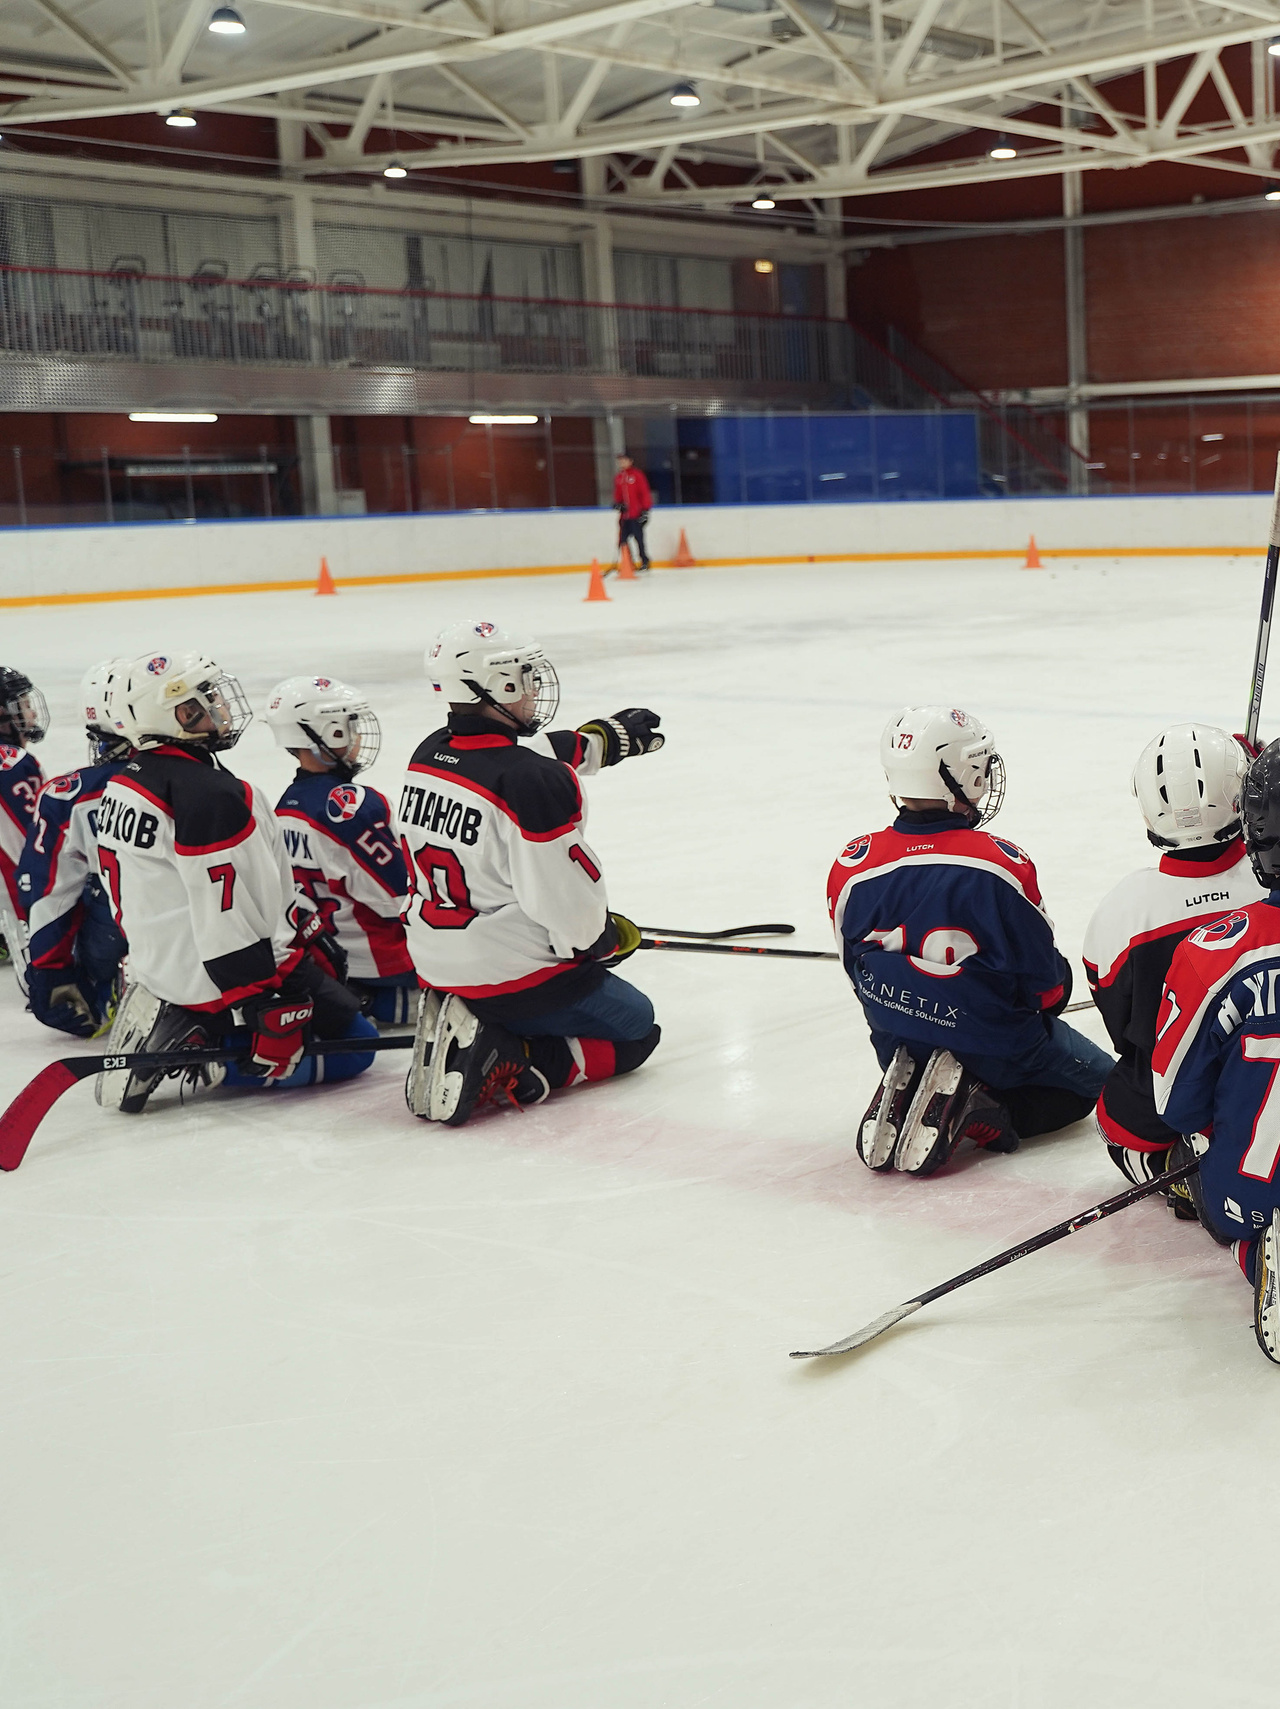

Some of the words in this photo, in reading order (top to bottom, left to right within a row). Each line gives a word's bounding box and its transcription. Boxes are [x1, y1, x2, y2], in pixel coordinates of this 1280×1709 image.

[897, 733, 913, 750] 73
[434, 752, 460, 765] LUTCH
[906, 844, 935, 852] LUTCH
[207, 862, 236, 913] 7
[1185, 891, 1230, 907] LUTCH
[883, 1000, 914, 1016] SIGNAGE
[915, 1010, 956, 1028] SOLUTIONS
